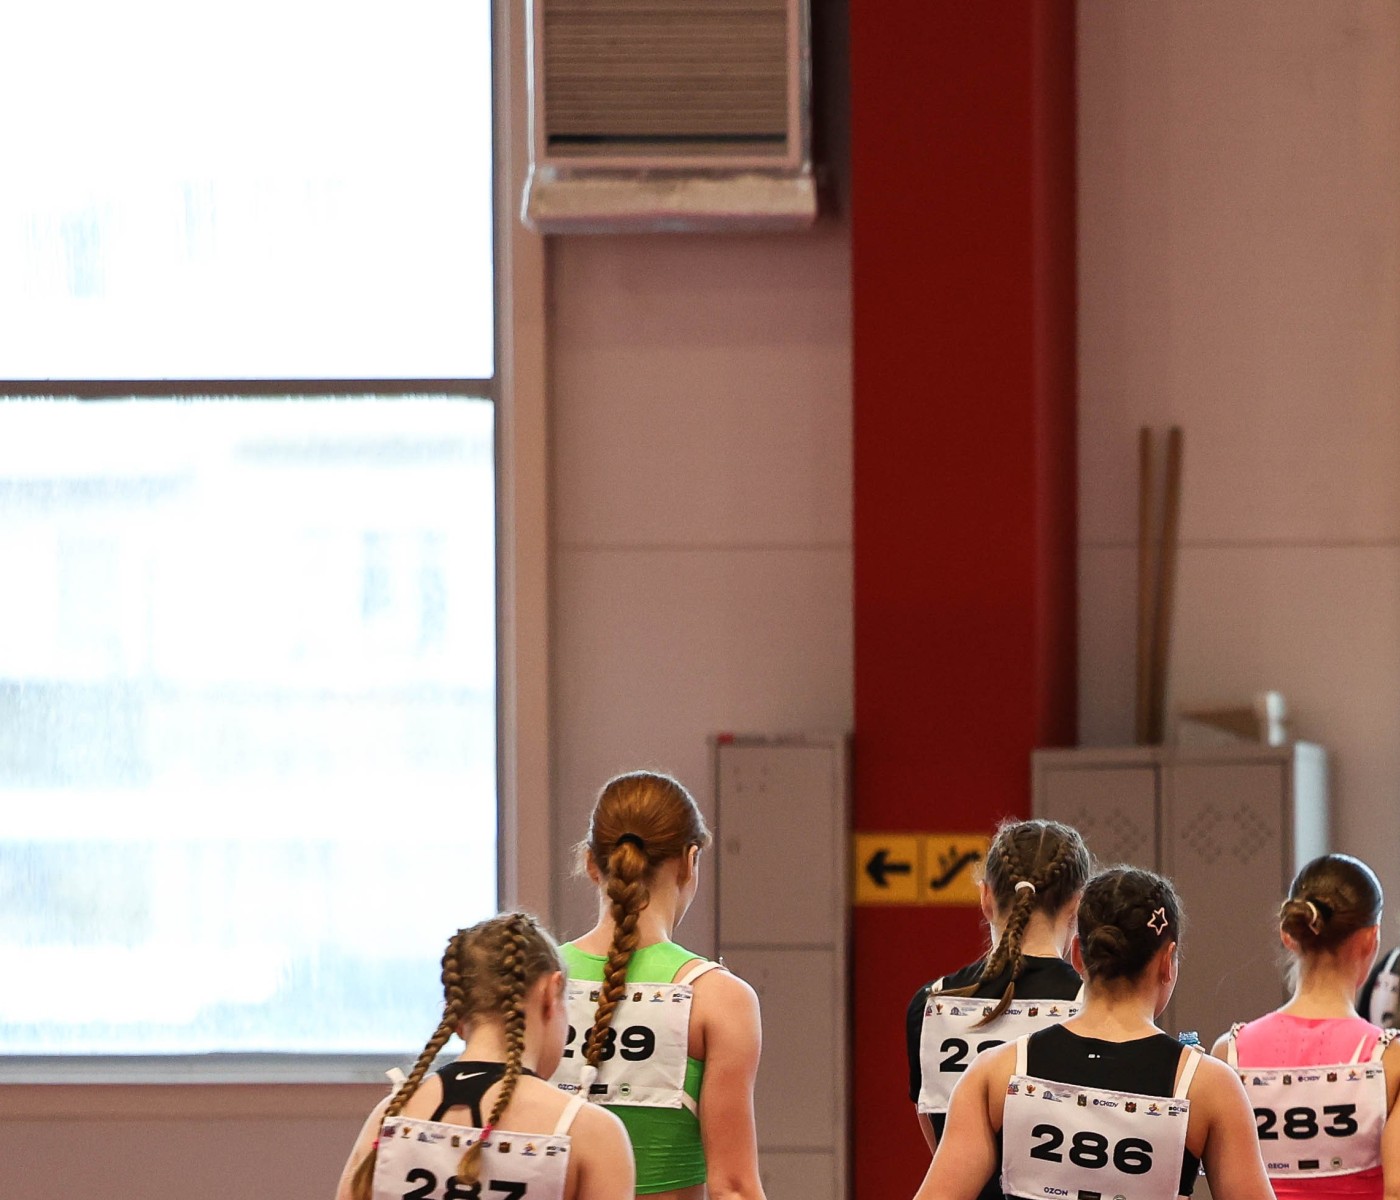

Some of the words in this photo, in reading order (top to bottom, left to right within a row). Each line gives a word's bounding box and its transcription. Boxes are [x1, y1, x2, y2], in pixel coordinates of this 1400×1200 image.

[1253, 1103, 1358, 1140] 283
[1030, 1124, 1153, 1174] 286
[1044, 1187, 1068, 1196] OZON
